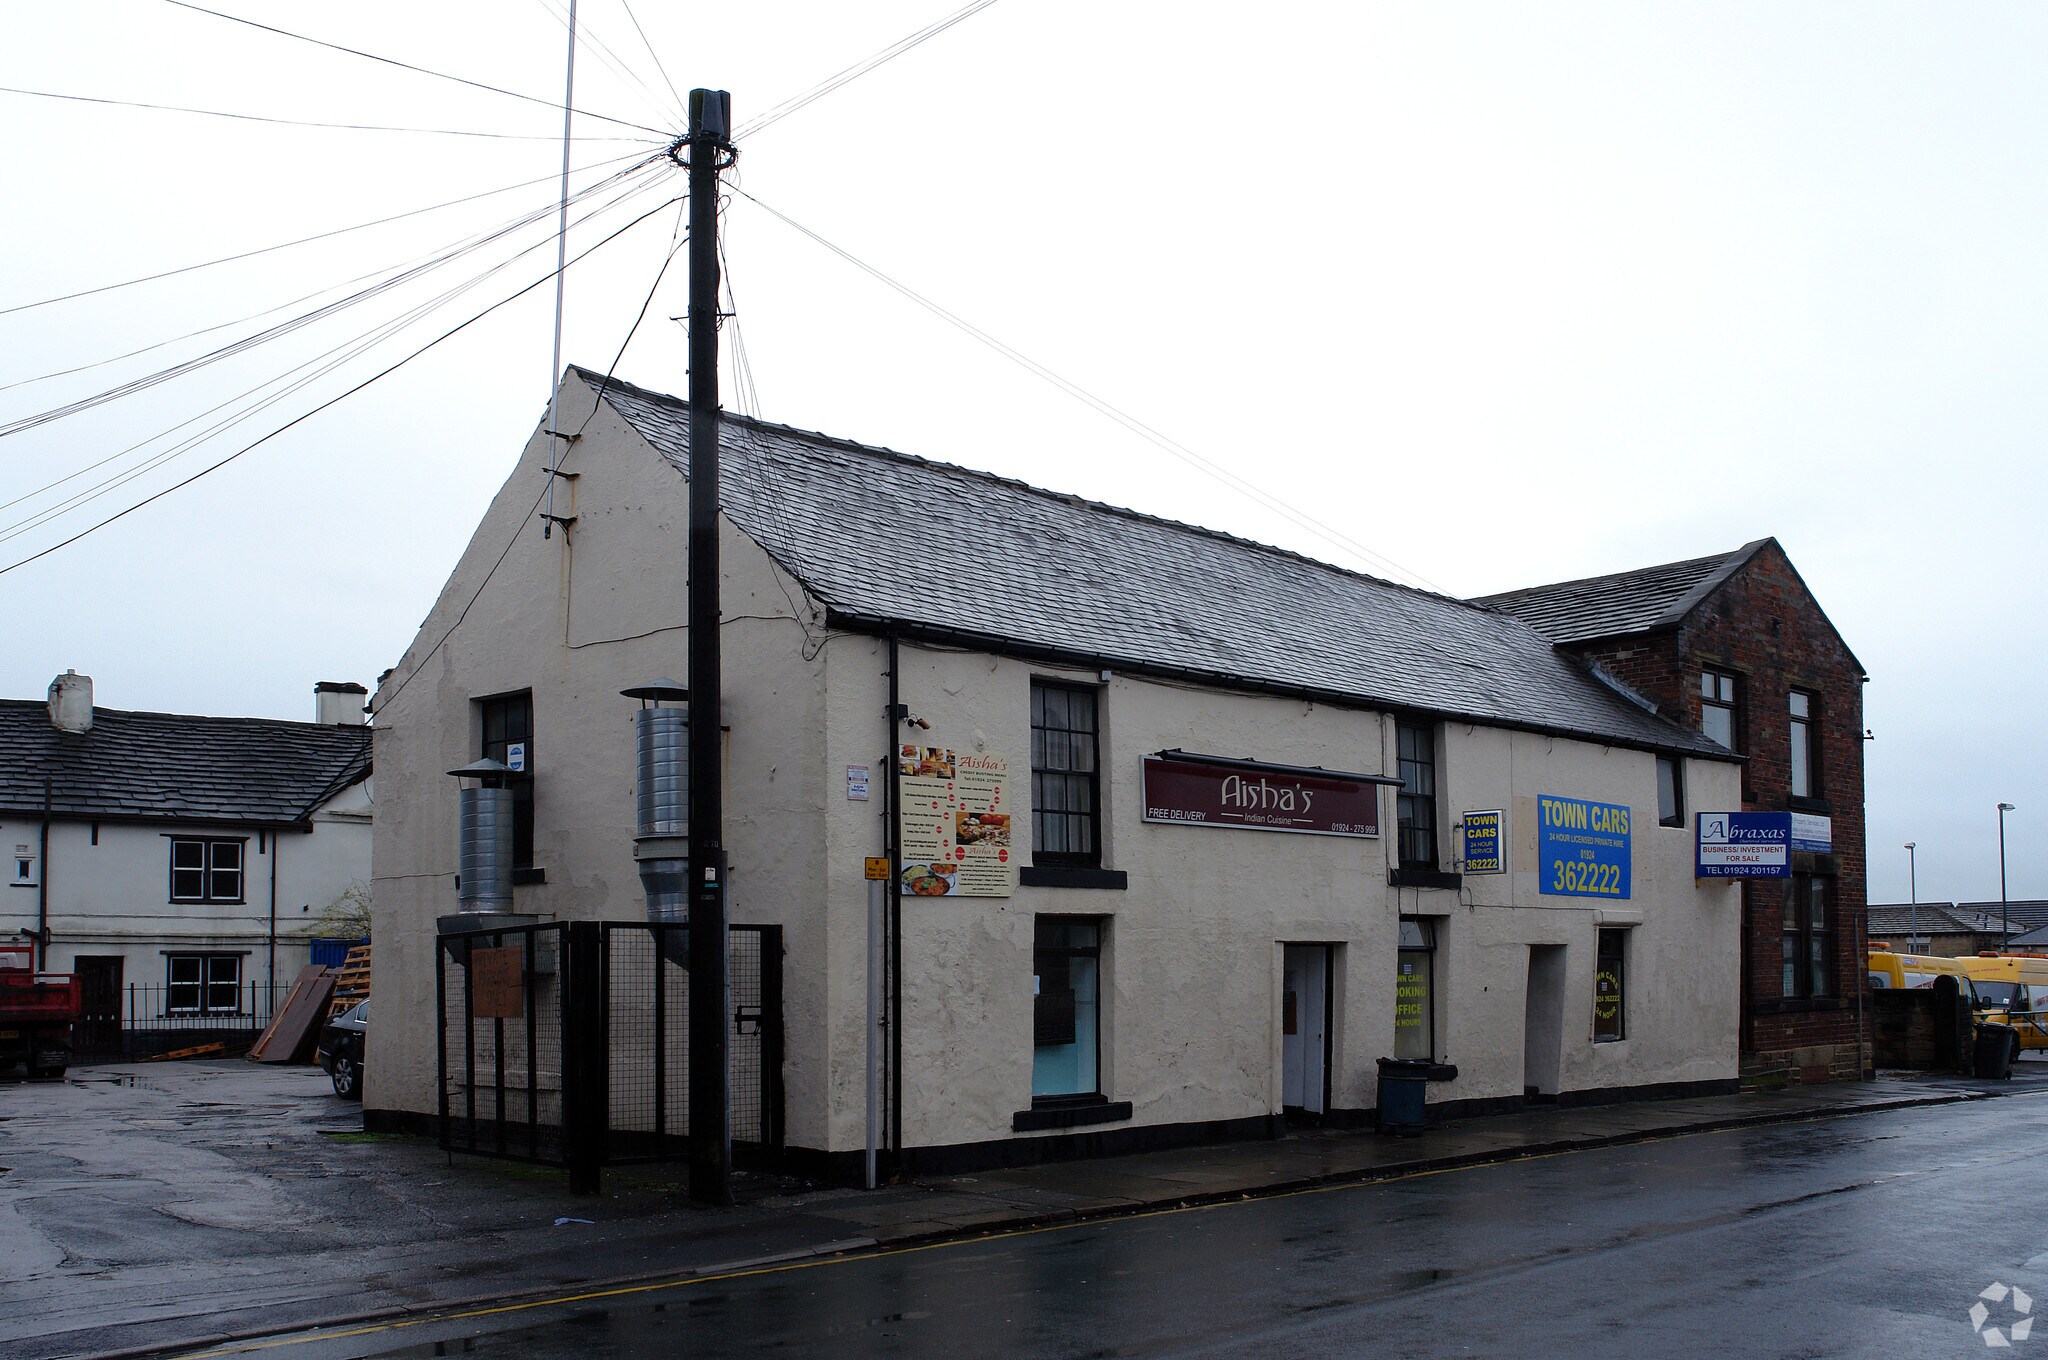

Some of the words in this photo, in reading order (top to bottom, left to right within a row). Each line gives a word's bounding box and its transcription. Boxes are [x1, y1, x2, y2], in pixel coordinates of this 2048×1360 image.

[959, 755, 1007, 771] Aisha's
[1221, 775, 1314, 813] Aisha's
[1149, 807, 1169, 819] FREE
[1170, 808, 1206, 821] DELIVERY
[1244, 812, 1266, 824] Indian
[1266, 814, 1292, 825] Cuisine
[1542, 799, 1587, 830] TOWN
[1591, 805, 1629, 835] CARS
[1466, 816, 1498, 826] TOWN
[1332, 822, 1350, 832] 01924
[1354, 824, 1365, 832] 275
[1364, 824, 1376, 834] 999
[1468, 828, 1497, 838] CARS
[1702, 820, 1786, 839] Abraxas
[1549, 833, 1556, 841] 24
[1556, 834, 1570, 843] HOUR
[1570, 835, 1594, 845] LICENSED
[1594, 836, 1613, 847] PRIVATE
[1613, 838, 1624, 848] HIRE
[968, 846, 997, 855] Aisha's
[1580, 849, 1595, 860] 01924
[1466, 858, 1498, 870] 362222
[1751, 866, 1781, 874] 201157
[1554, 860, 1620, 894] 362222
[1606, 972, 1618, 990] CARS
[1602, 1006, 1616, 1019] HOUR
